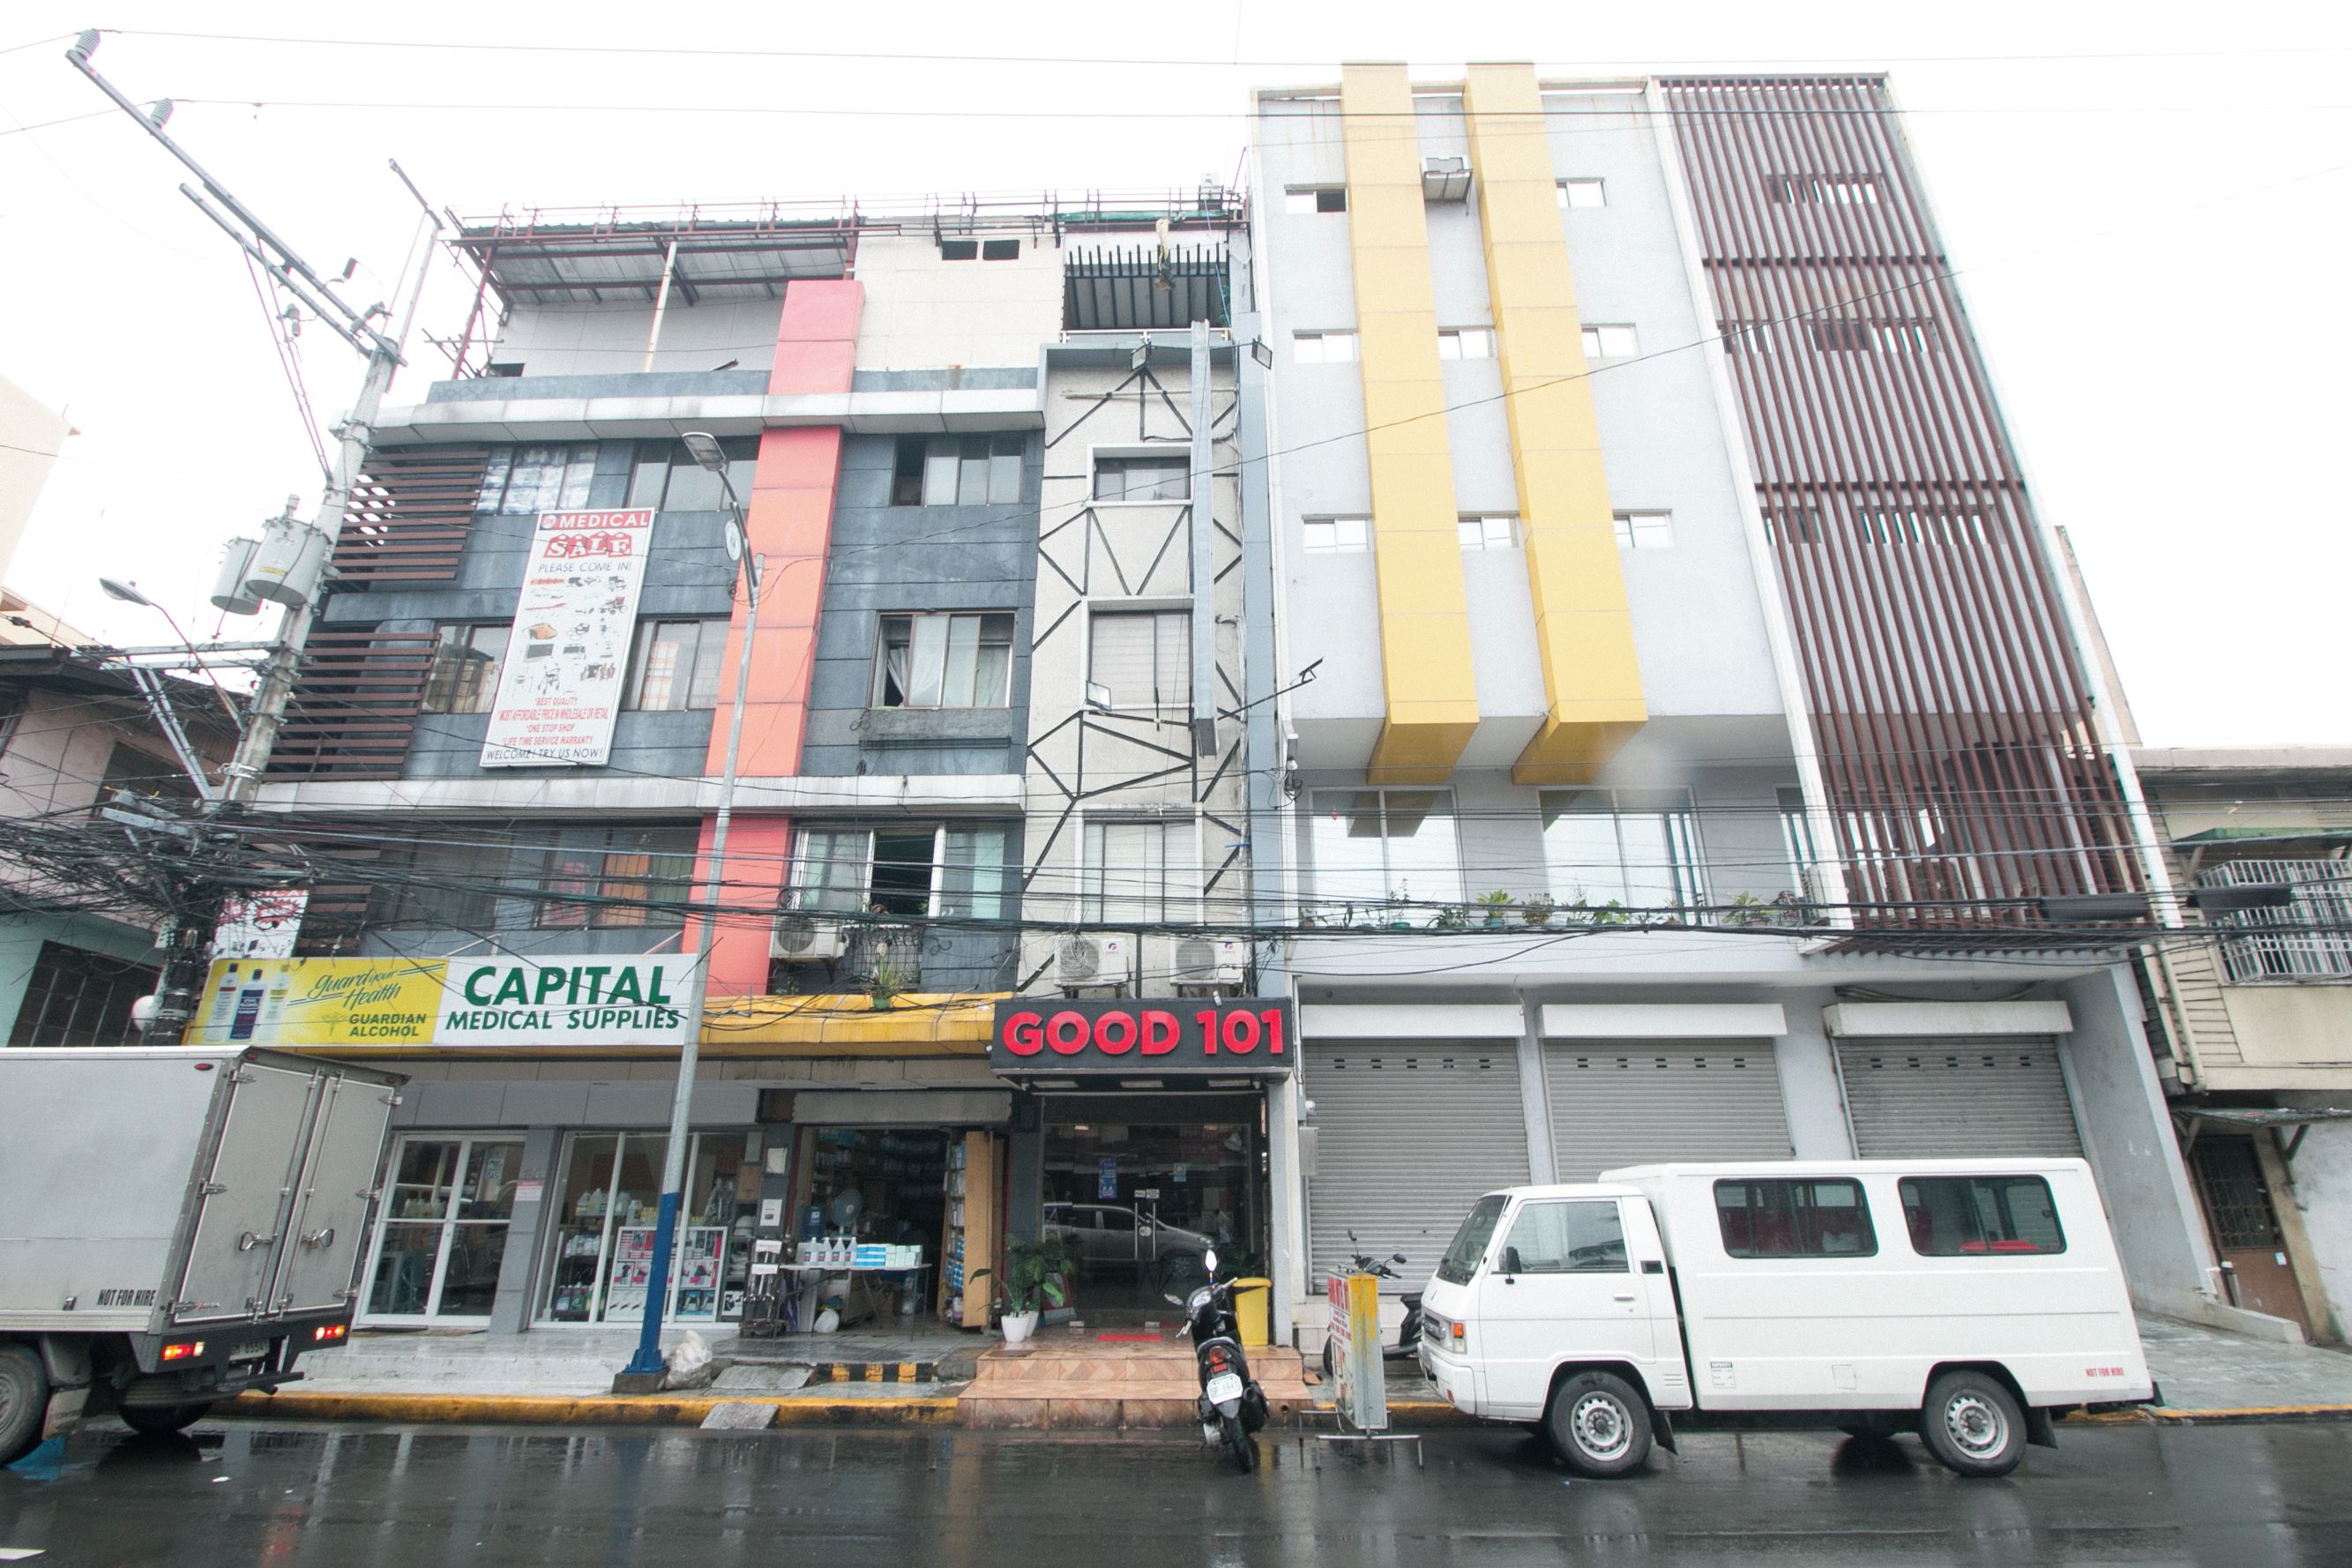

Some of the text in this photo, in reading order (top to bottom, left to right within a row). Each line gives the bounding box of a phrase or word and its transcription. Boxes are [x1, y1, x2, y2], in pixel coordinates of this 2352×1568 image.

[559, 513, 648, 528] MEDICAL
[547, 538, 631, 556] SALE
[539, 562, 631, 573] PLEASE COME IN!
[553, 697, 579, 706] QUALITY
[512, 709, 541, 721] AFFORDABLE
[559, 708, 587, 720] WHOLESALE
[541, 723, 558, 733] STOP
[558, 723, 575, 732] SHOP
[519, 736, 534, 746] TIME
[534, 735, 559, 745] SERVICE
[560, 735, 594, 745] WARRANTY
[487, 747, 603, 760] WELCOME! TRY US NOW!
[464, 965, 672, 1007] CAPITAL
[342, 982, 402, 1011] Health
[349, 1013, 427, 1025] GUARDIAN
[445, 1009, 679, 1030] MEDICAL SUPPLIES
[348, 1026, 420, 1037] ALCOHOL
[1002, 1009, 1284, 1056] GOOD 101
[97, 1289, 157, 1306] NOT FOR HIRE
[2085, 1367, 2125, 1378] NOT FOR HIRE
